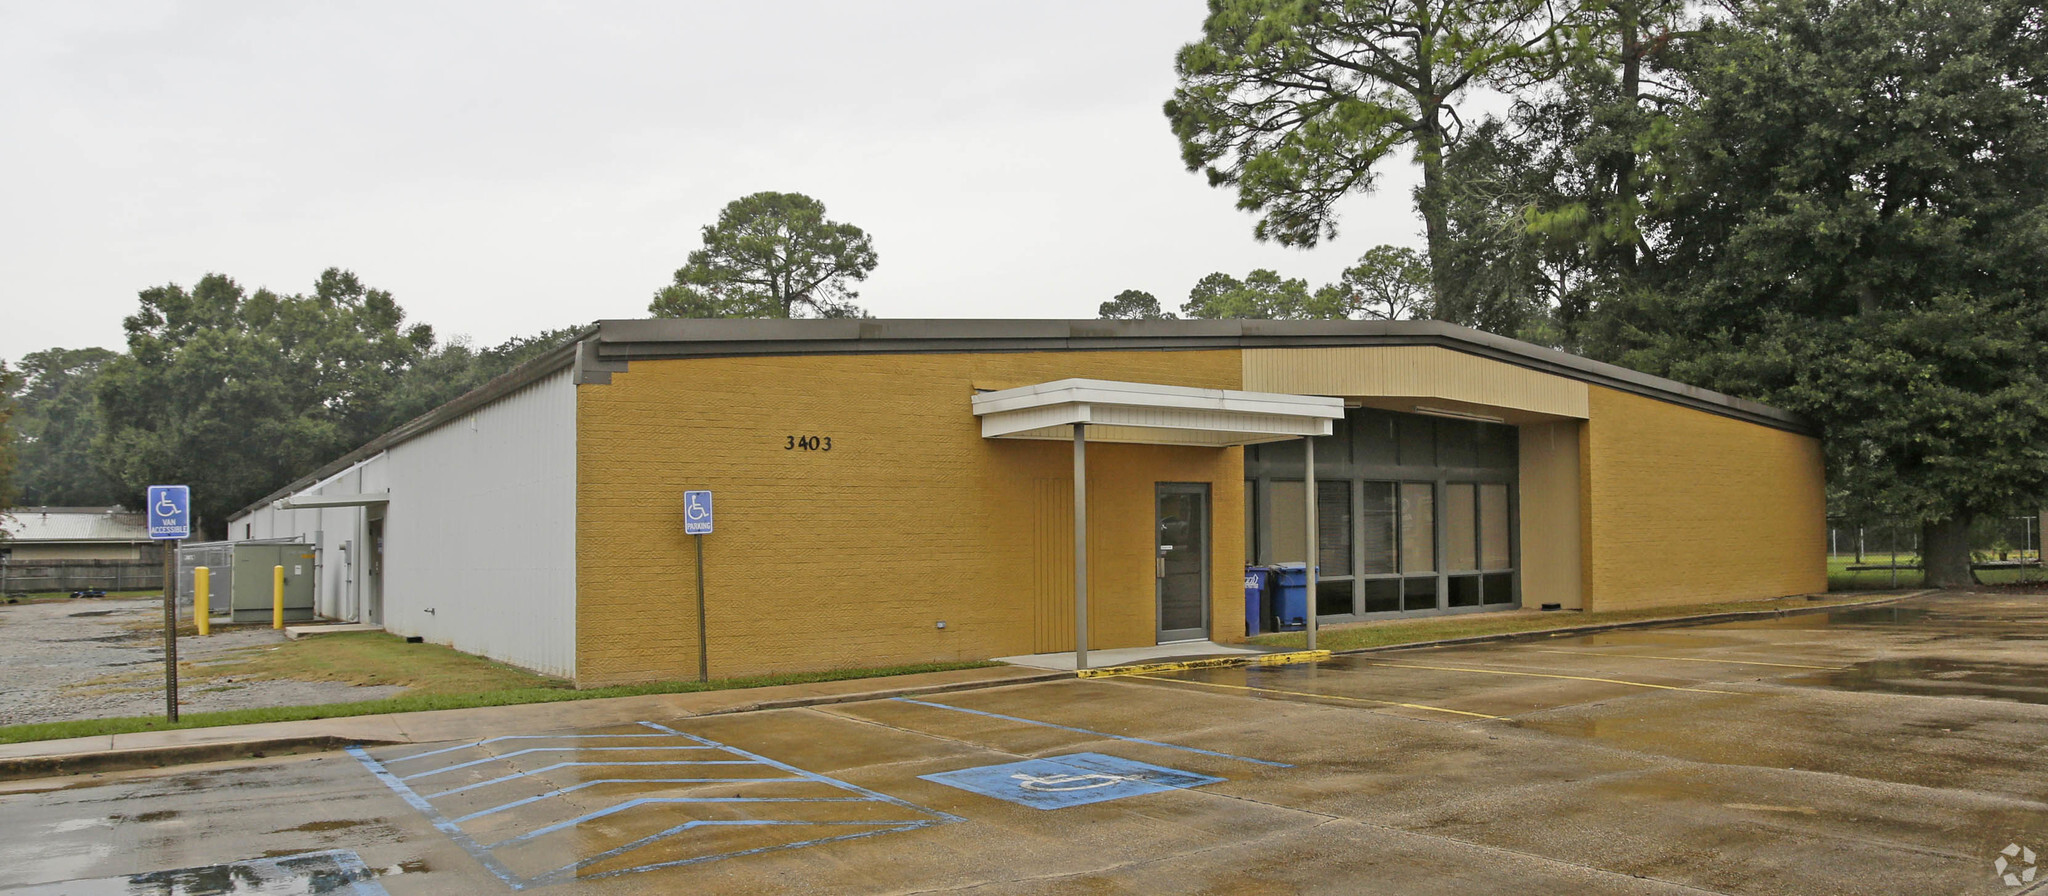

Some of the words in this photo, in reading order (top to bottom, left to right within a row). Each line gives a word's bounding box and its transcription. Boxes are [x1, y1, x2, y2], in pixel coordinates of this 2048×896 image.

[784, 434, 832, 451] 3403
[162, 518, 176, 526] VAN
[687, 522, 711, 530] PARKING
[151, 525, 187, 534] ACCESSIBLE
